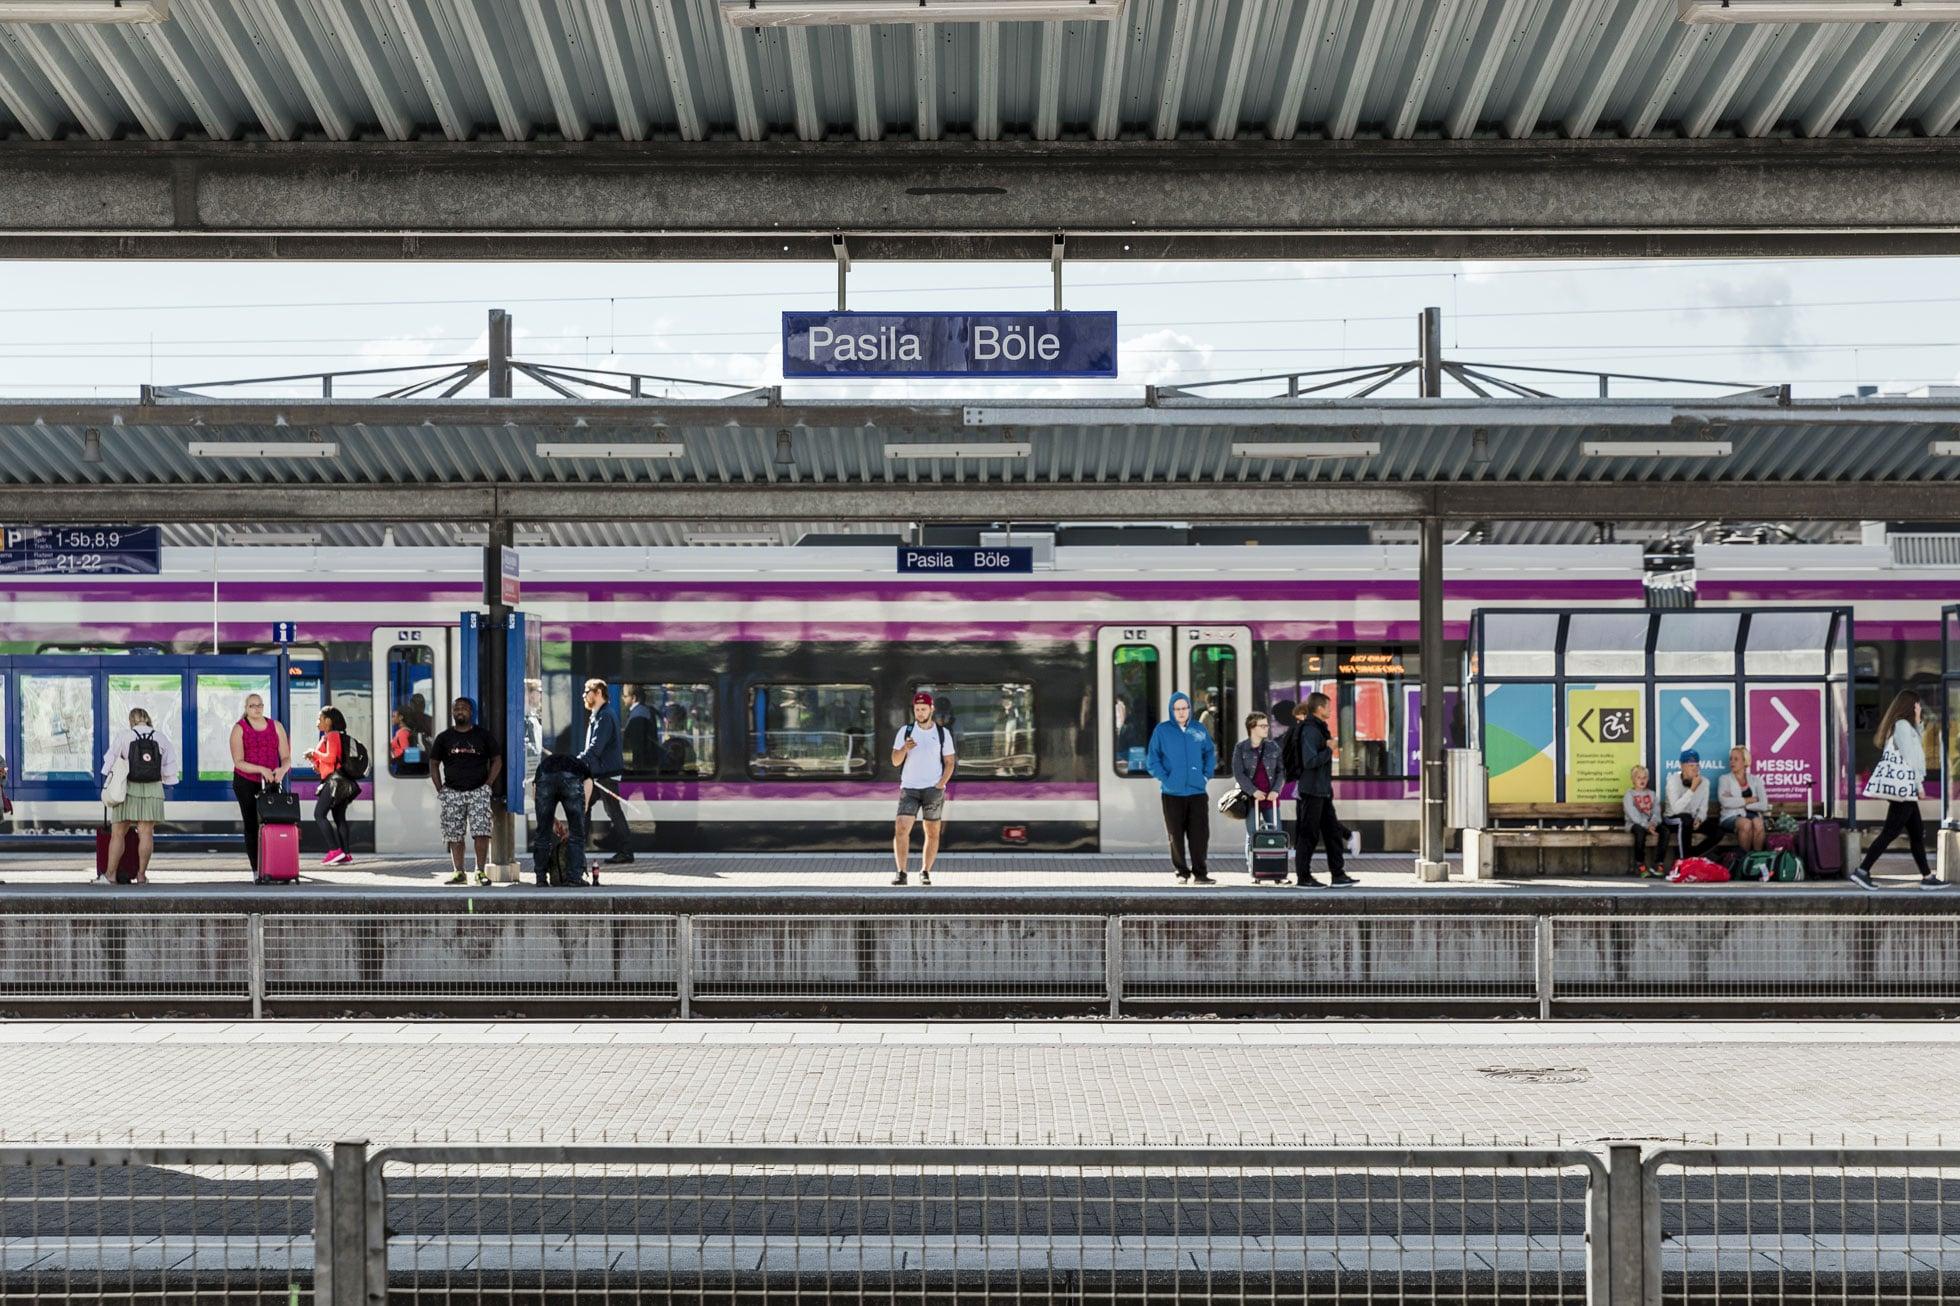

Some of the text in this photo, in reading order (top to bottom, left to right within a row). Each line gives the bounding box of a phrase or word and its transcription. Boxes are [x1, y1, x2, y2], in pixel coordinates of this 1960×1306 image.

[808, 325, 1060, 361] Pasila Böle
[56, 532, 120, 549] 1-5b,8,9
[56, 554, 102, 569] 21-22
[907, 552, 1010, 568] Pasila Böle
[1756, 759, 1811, 771] MESSU-
[1757, 773, 1813, 786] KESKUS
